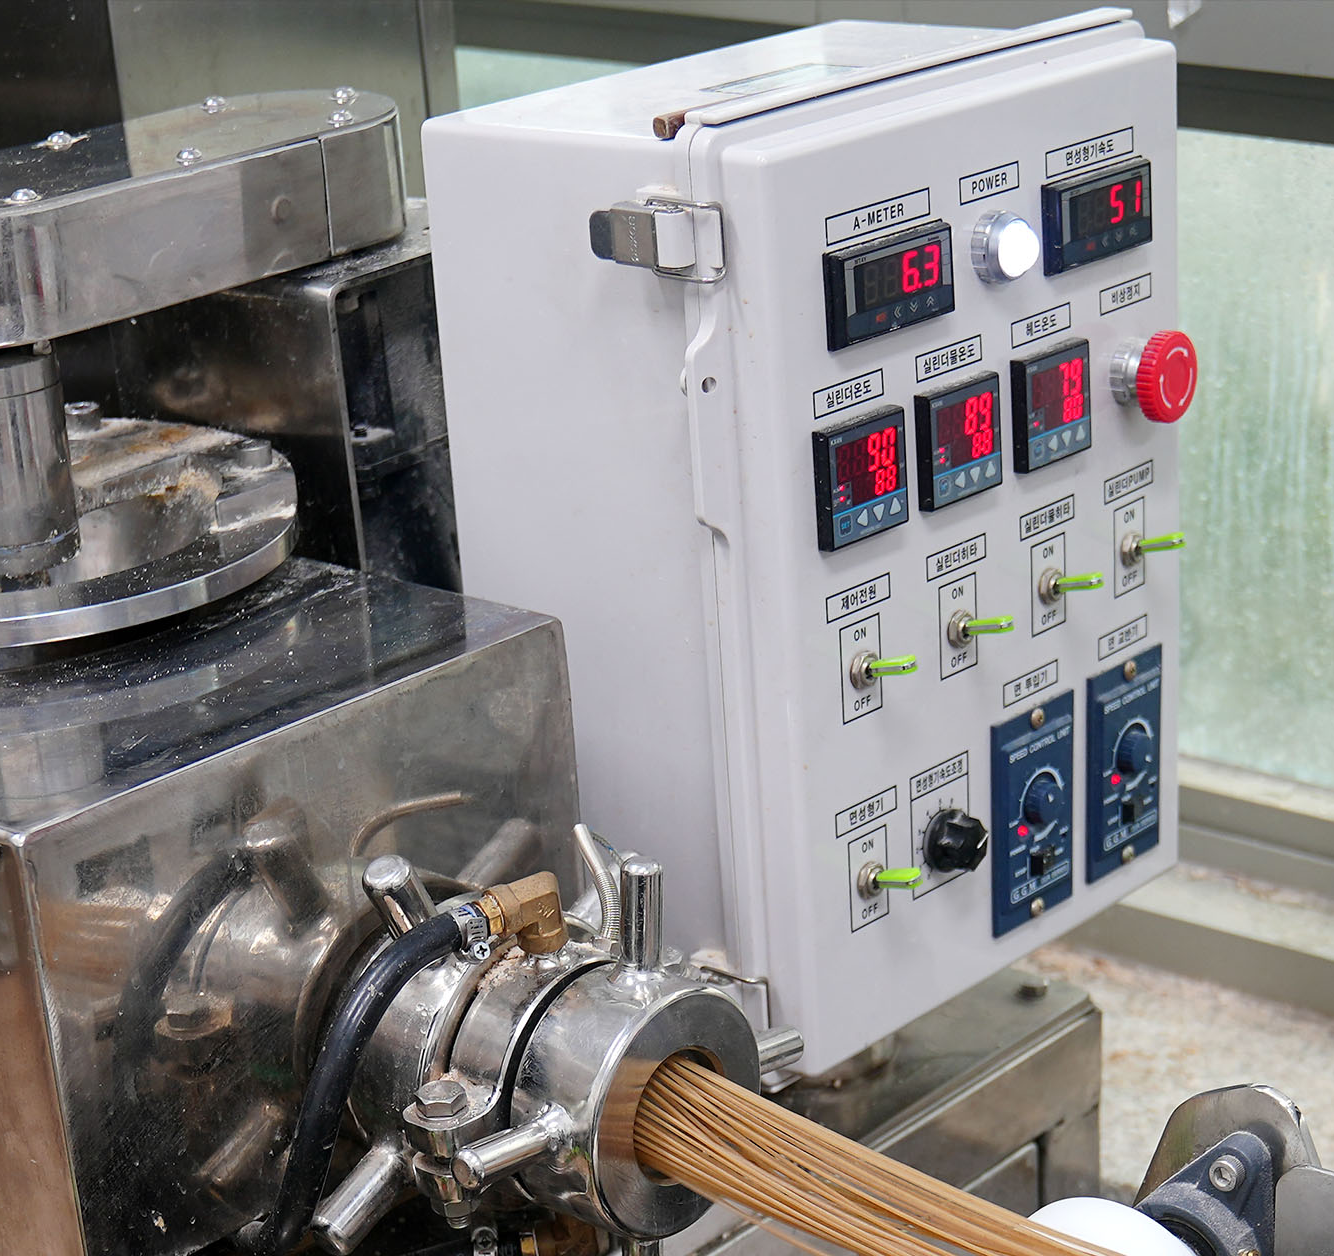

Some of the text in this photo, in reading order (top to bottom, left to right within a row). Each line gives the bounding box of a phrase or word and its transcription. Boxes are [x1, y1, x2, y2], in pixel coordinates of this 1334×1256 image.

[1065, 139, 1115, 166] 면성형기속도
[971, 172, 1008, 195] POWER
[1109, 180, 1142, 224] 51
[852, 203, 905, 231] A-METER
[902, 244, 941, 293] 6.3
[1111, 282, 1141, 304] 비상정지
[1025, 313, 1057, 337] 헤드온도
[923, 343, 976, 375] 실린더물온도
[825, 379, 872, 409] 실린더온도
[964, 391, 994, 436] 89
[867, 426, 897, 472] 90
[874, 464, 897, 496] 88
[1123, 509, 1135, 524] ON
[935, 543, 978, 573] 실린더히타
[1042, 545, 1054, 559] ON
[1122, 570, 1138, 587] OFF
[840, 584, 877, 611] 제어전원
[951, 585, 964, 600] ON
[1041, 609, 1057, 626] OFF
[853, 627, 867, 642] ON
[950, 651, 967, 668] OFF
[853, 694, 872, 712] OFF
[1009, 725, 1071, 764] SPEED CONTROL UNIT
[848, 797, 884, 827] 면성형기
[861, 838, 875, 854] ON
[861, 902, 879, 920] OFF
